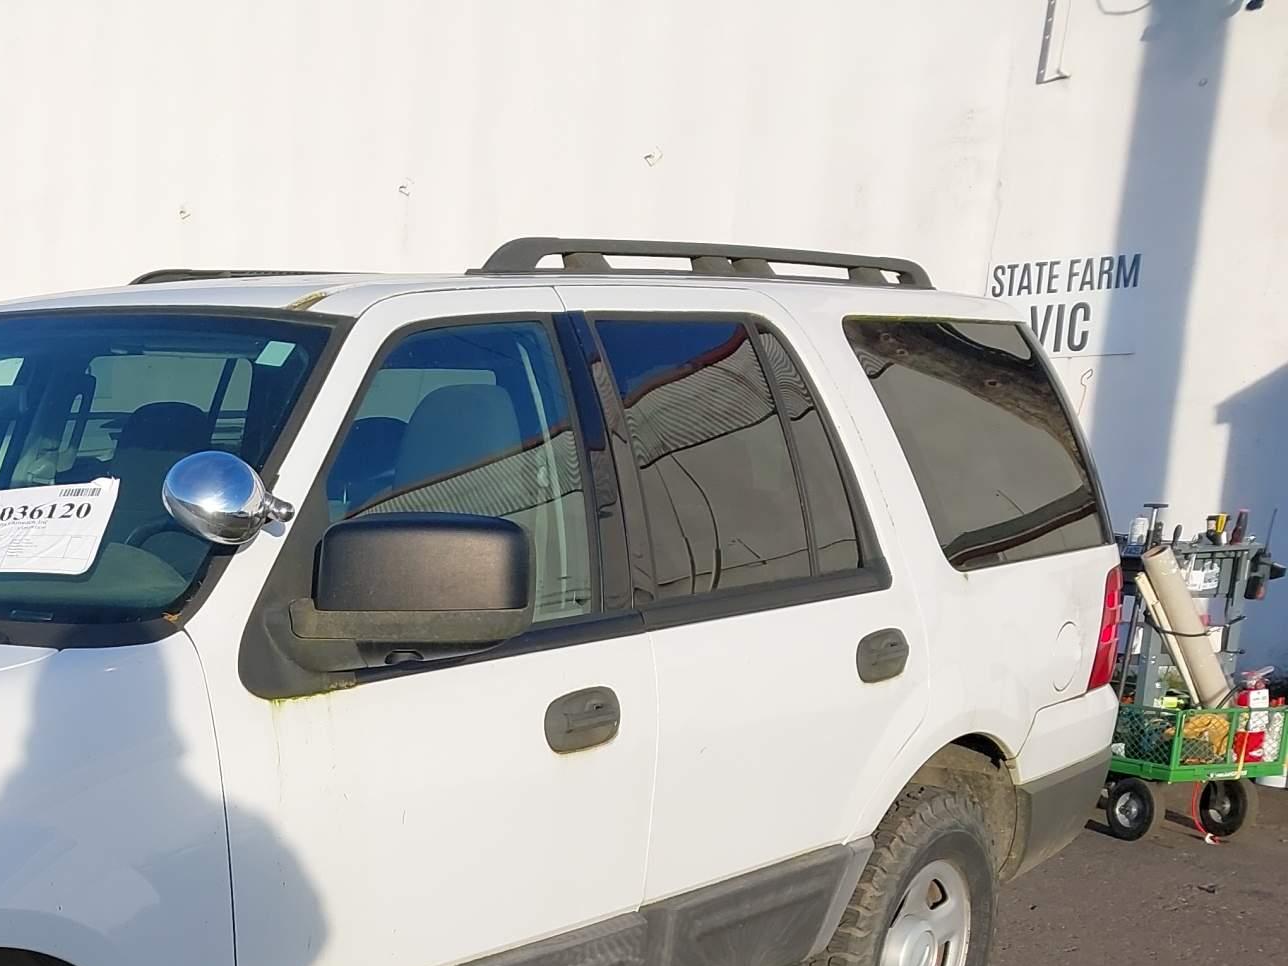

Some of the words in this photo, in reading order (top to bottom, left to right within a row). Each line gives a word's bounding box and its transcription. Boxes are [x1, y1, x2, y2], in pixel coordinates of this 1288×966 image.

[991, 261, 1061, 298] STATE
[1067, 253, 1141, 293] FARM
[1030, 302, 1091, 353] VIC
